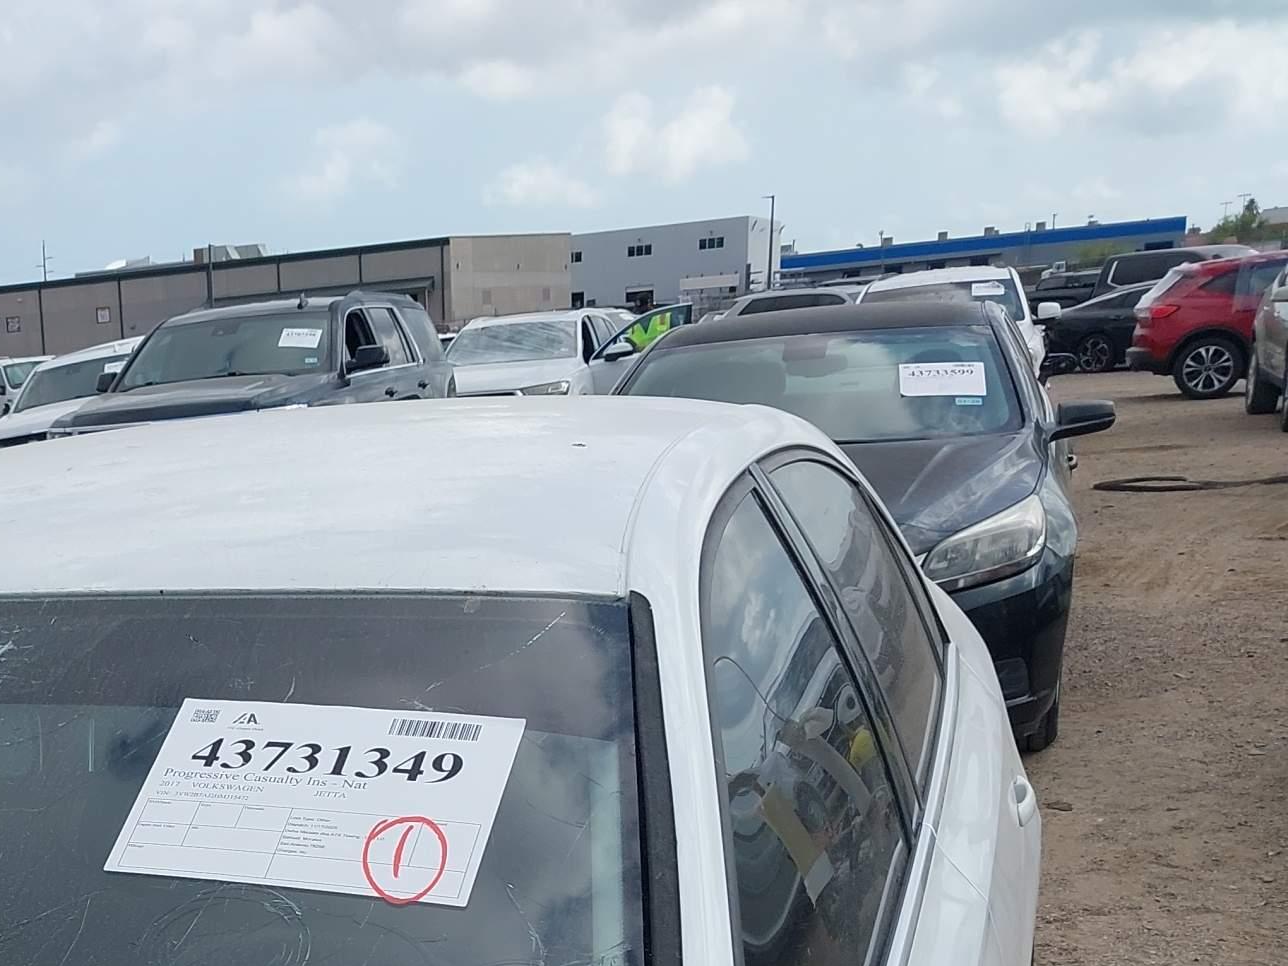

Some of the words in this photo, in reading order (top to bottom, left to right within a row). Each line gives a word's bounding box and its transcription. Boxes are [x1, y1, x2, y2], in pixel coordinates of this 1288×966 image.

[191, 737, 464, 784] 43731349
[163, 767, 241, 782] Progressive
[243, 772, 303, 787] Casualty
[306, 776, 328, 787] Ins
[341, 779, 368, 790] Nat
[192, 781, 265, 793] VOLKSWAGEN
[313, 790, 347, 799] JETTA
